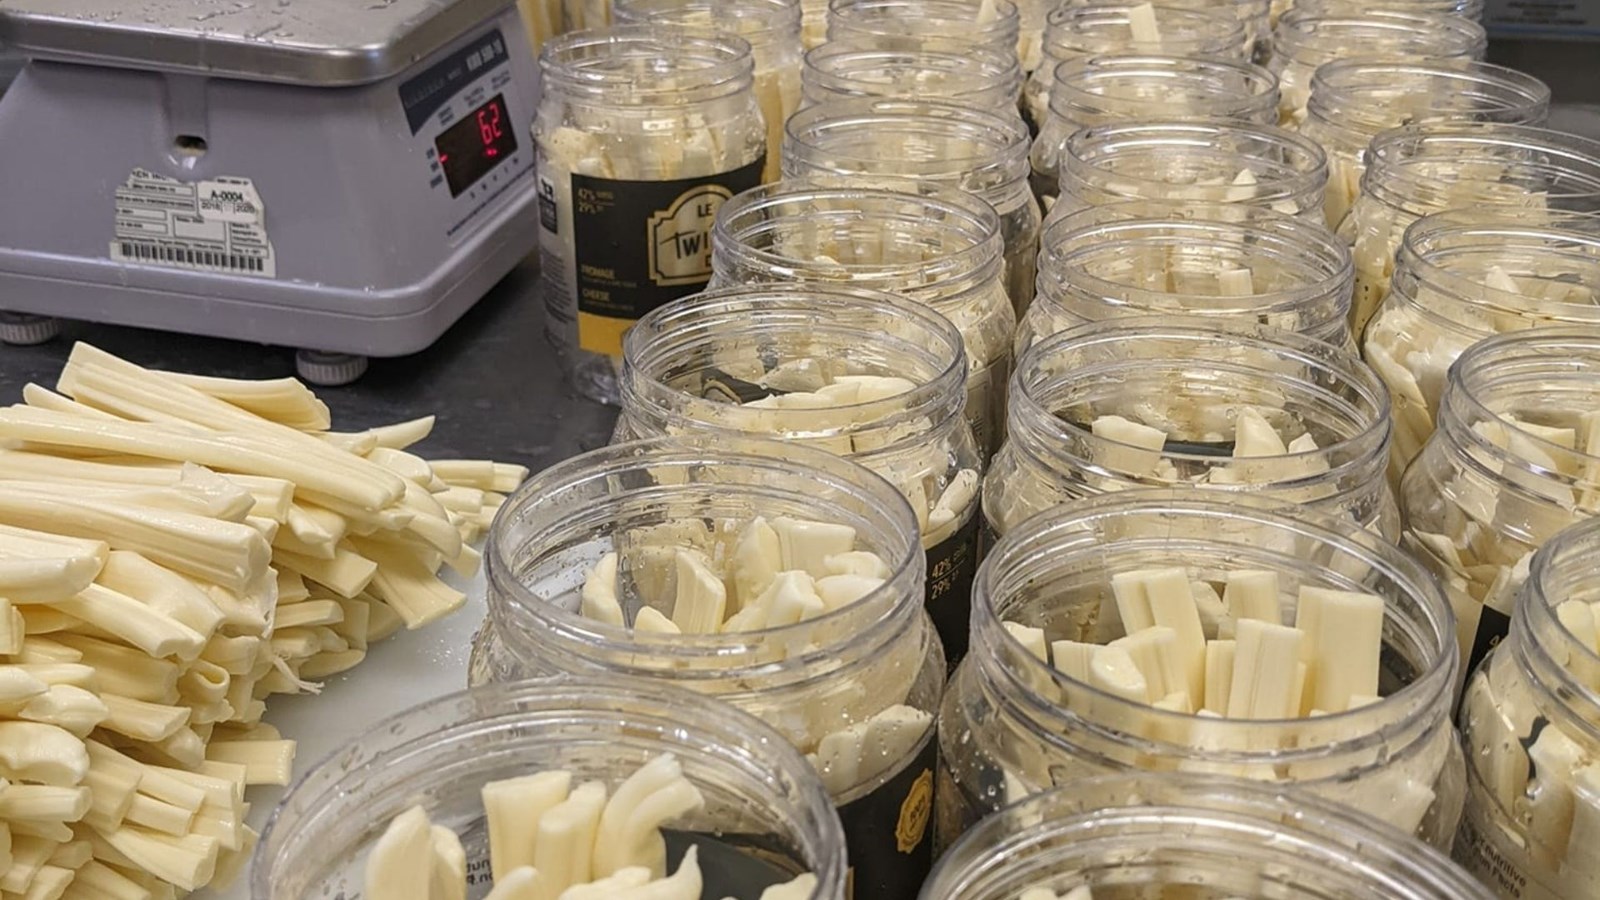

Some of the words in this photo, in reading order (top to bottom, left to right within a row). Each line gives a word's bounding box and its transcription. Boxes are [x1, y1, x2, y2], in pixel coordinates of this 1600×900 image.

[211, 190, 244, 203] A-0004
[697, 204, 713, 218] LE
[660, 231, 710, 260] TWI
[932, 558, 951, 578] 42%
[931, 579, 951, 600] 29%
